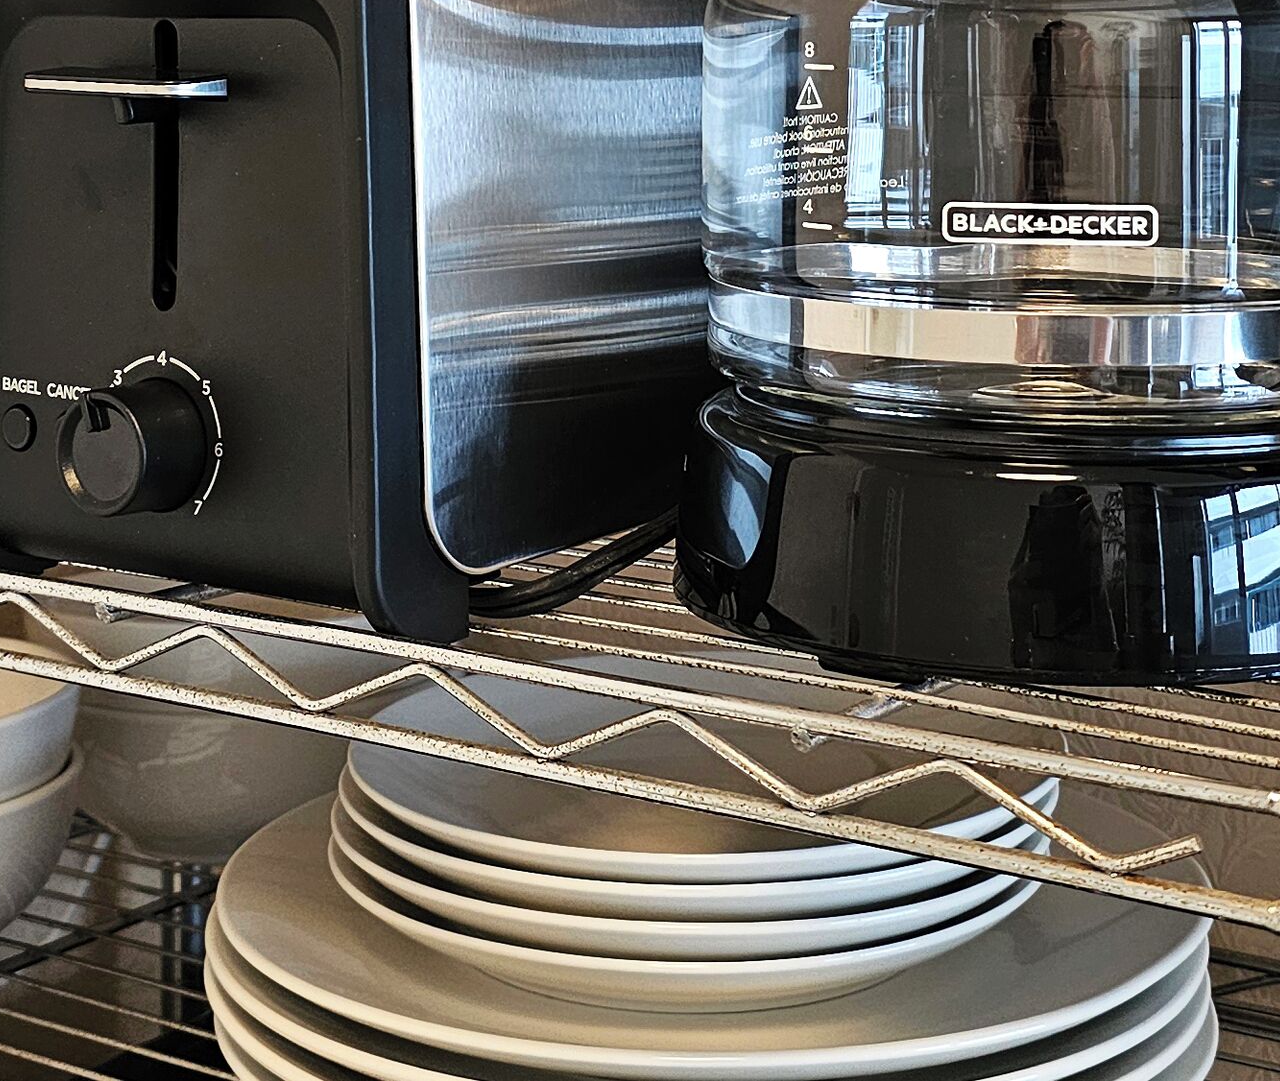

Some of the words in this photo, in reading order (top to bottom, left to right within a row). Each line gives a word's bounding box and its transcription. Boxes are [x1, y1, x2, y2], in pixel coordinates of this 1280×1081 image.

[804, 41, 815, 58] 8
[803, 125, 814, 141] 6
[803, 198, 814, 214] 4
[952, 212, 1148, 236] BLACK+DECKER
[156, 350, 168, 367] 4
[1, 376, 42, 396] BAGEL
[113, 369, 123, 386] 3
[202, 379, 212, 396] 5
[214, 442, 224, 458] 6
[193, 500, 204, 516] 7
